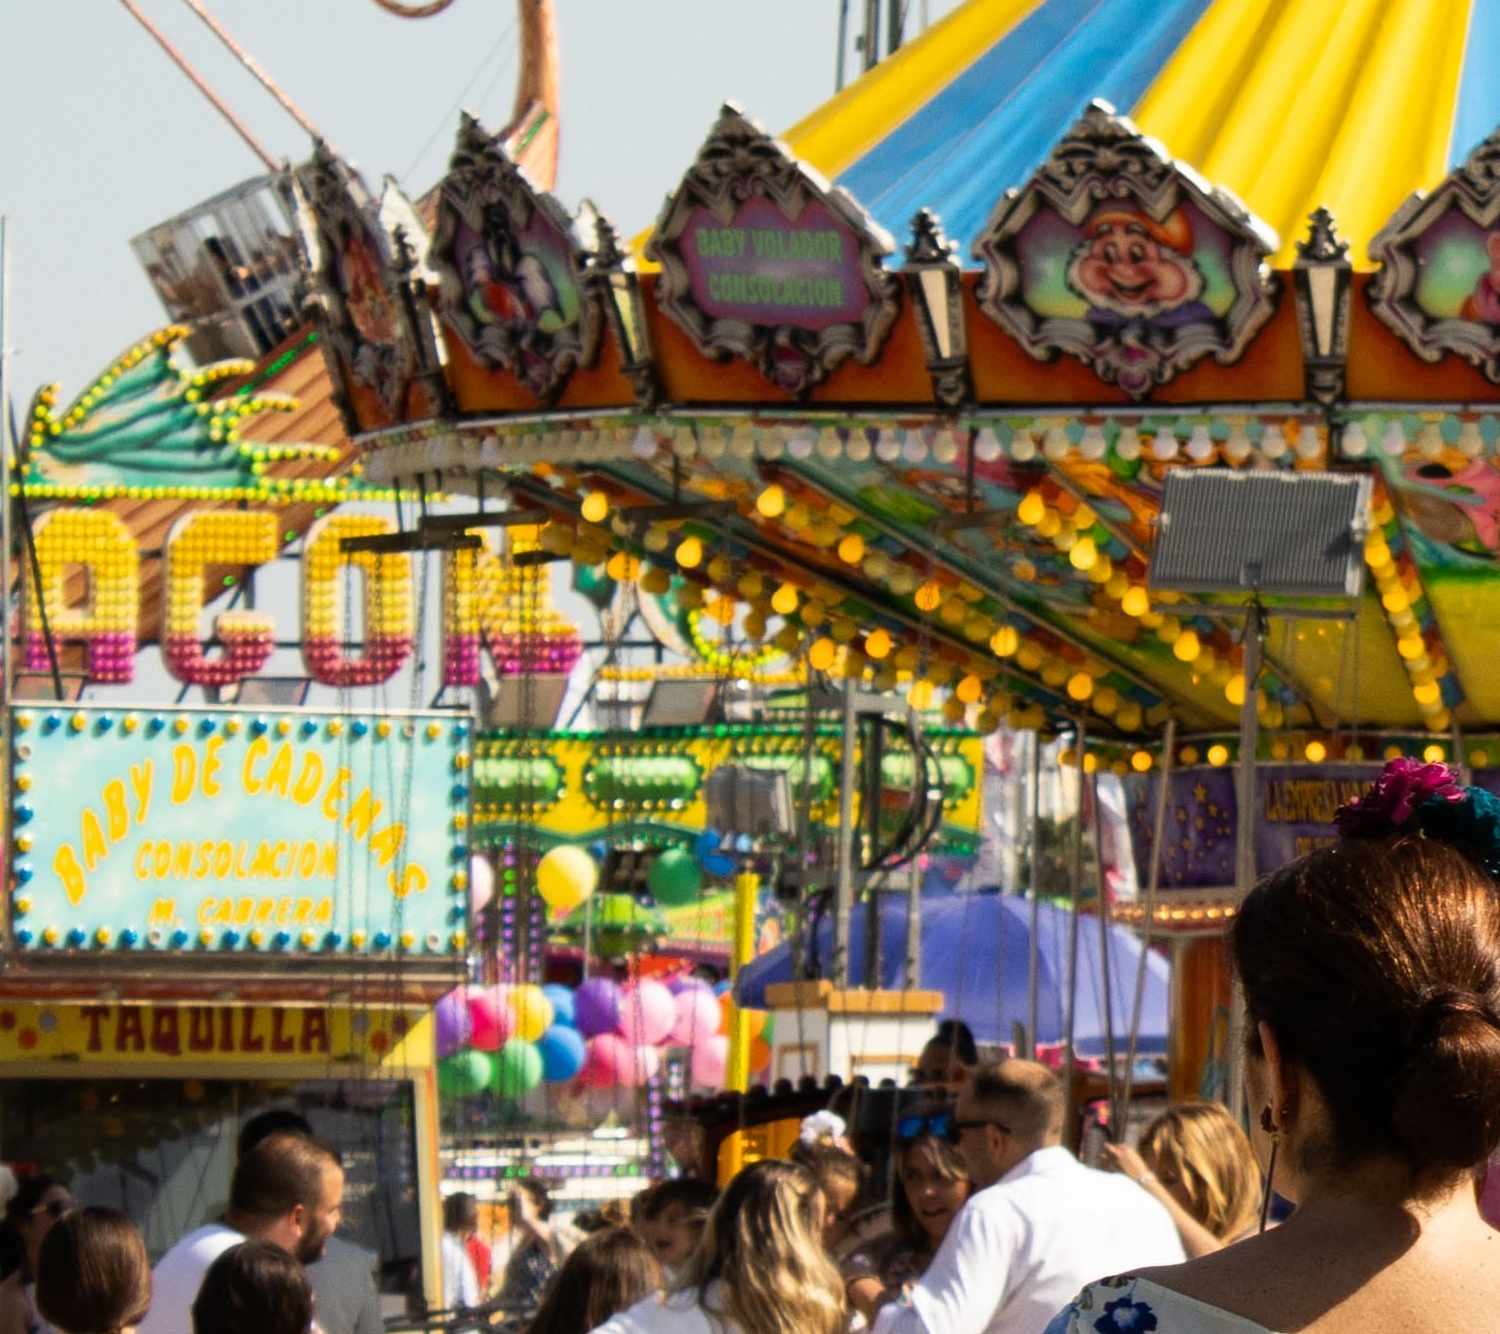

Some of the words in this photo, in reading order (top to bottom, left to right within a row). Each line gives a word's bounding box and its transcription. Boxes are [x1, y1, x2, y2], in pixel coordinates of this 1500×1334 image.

[696, 228, 745, 258] BABY
[752, 229, 843, 265] VOLADOR
[52, 758, 153, 905] BABY
[171, 734, 225, 805] DE
[242, 734, 430, 899] CADENAS
[134, 838, 340, 881] CONSOLACION
[148, 897, 182, 927] M.
[196, 897, 334, 926] CABRERA
[79, 1005, 332, 1057] TAQUILLA
